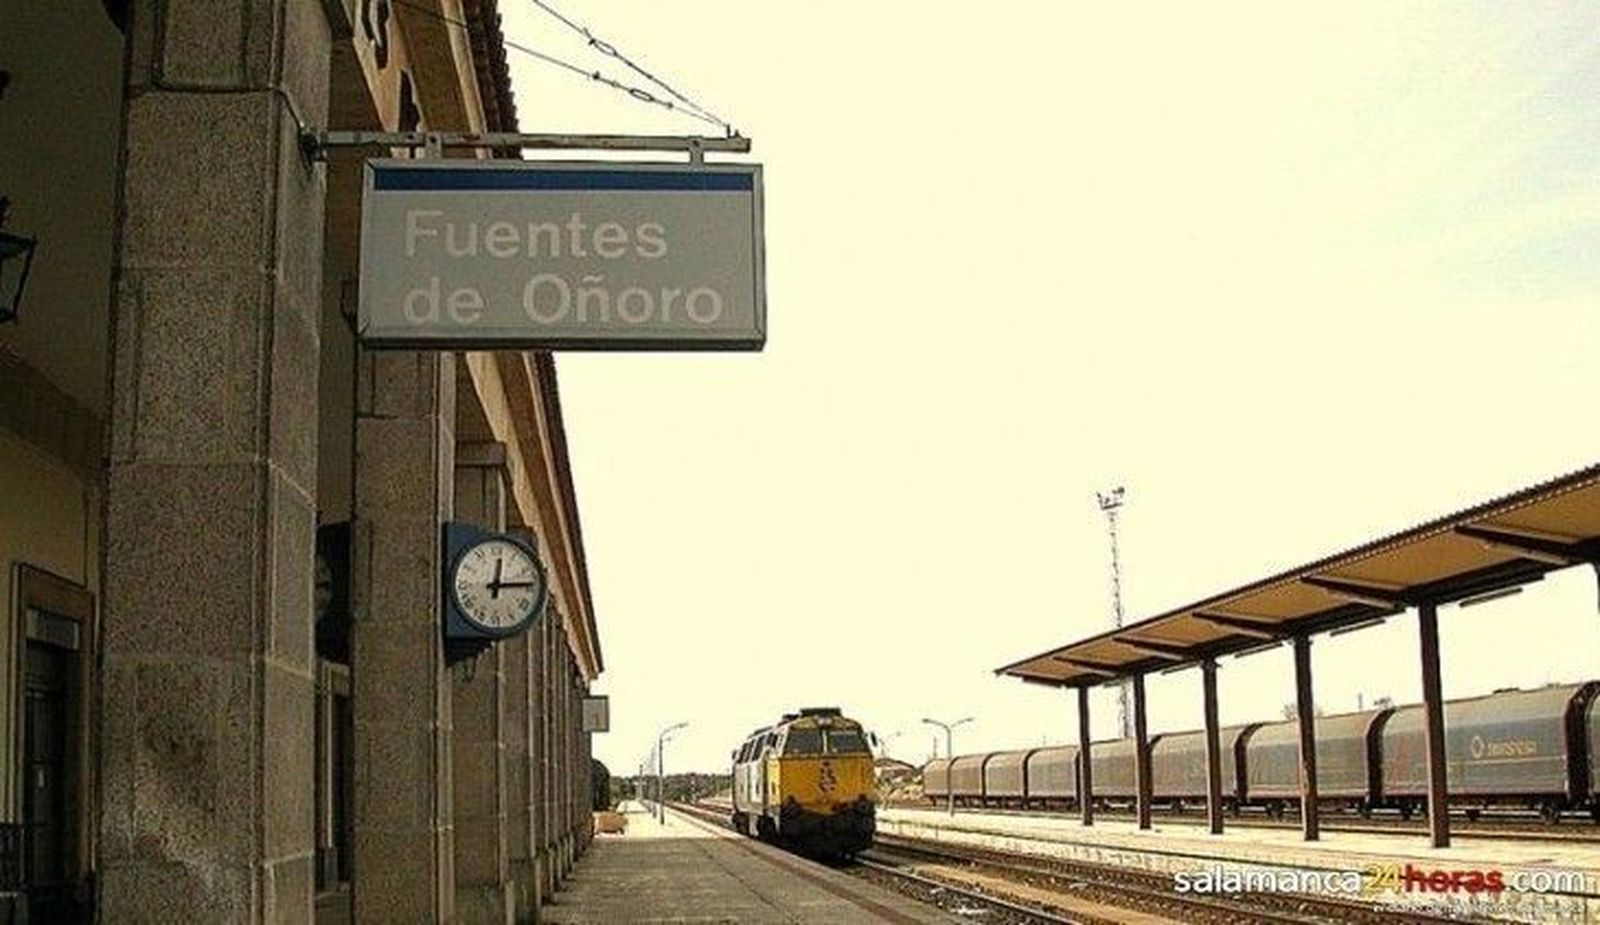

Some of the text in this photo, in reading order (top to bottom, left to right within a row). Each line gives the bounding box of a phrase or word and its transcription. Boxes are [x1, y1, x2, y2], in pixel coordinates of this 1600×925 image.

[404, 209, 669, 259] Fuentes
[404, 272, 724, 325] de Oñoro
